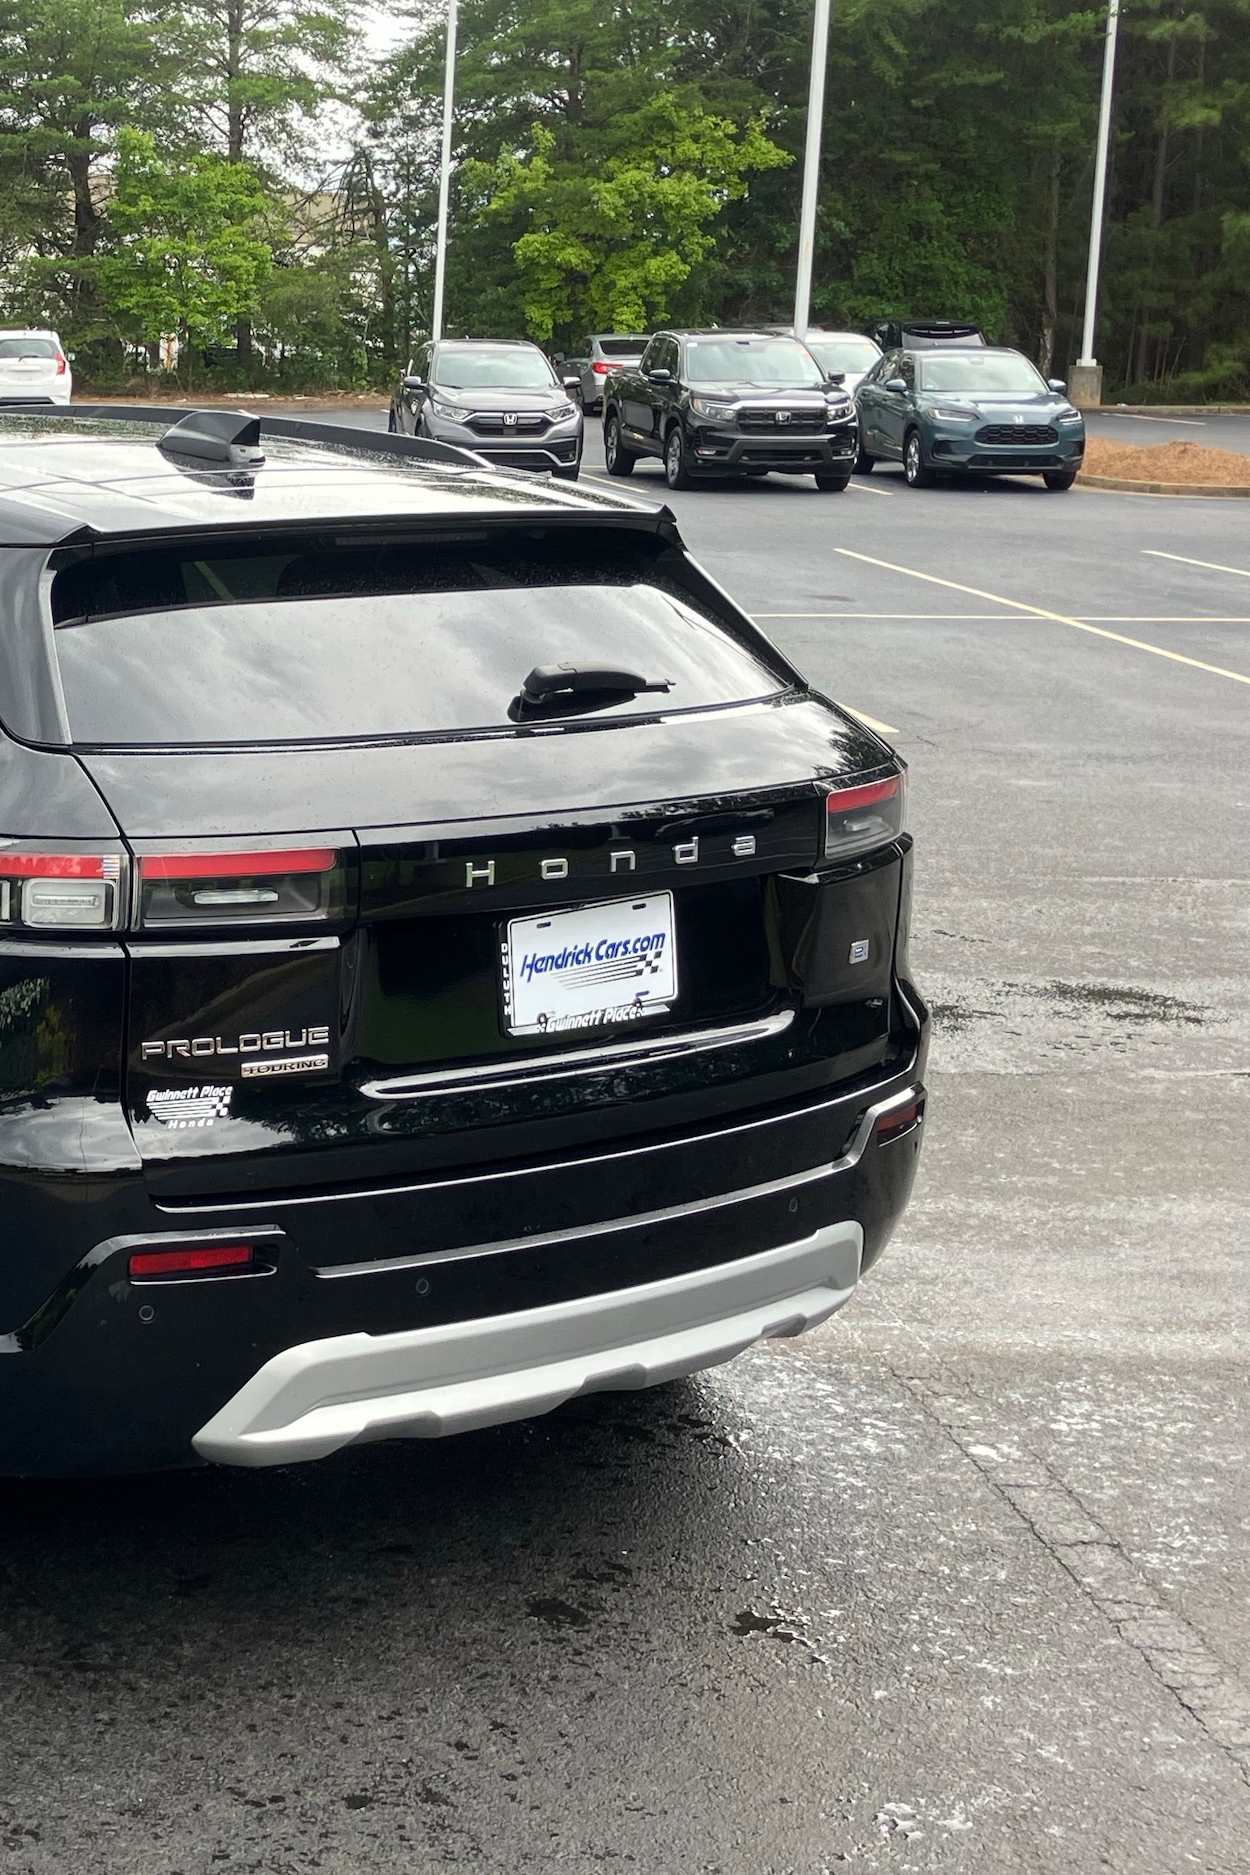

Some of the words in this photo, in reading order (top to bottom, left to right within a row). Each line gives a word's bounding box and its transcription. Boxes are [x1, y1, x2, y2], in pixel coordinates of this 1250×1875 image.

[465, 835, 756, 889] Honda
[501, 942, 511, 1016] DULUTH
[547, 1010, 602, 1033] Gwinnett
[603, 1006, 636, 1025] Place
[141, 1026, 330, 1061] PROLOGUE
[244, 1058, 326, 1076] TOURING
[146, 1087, 199, 1102] Gwinnett
[200, 1085, 233, 1098] Place
[167, 1118, 214, 1130] Honda
